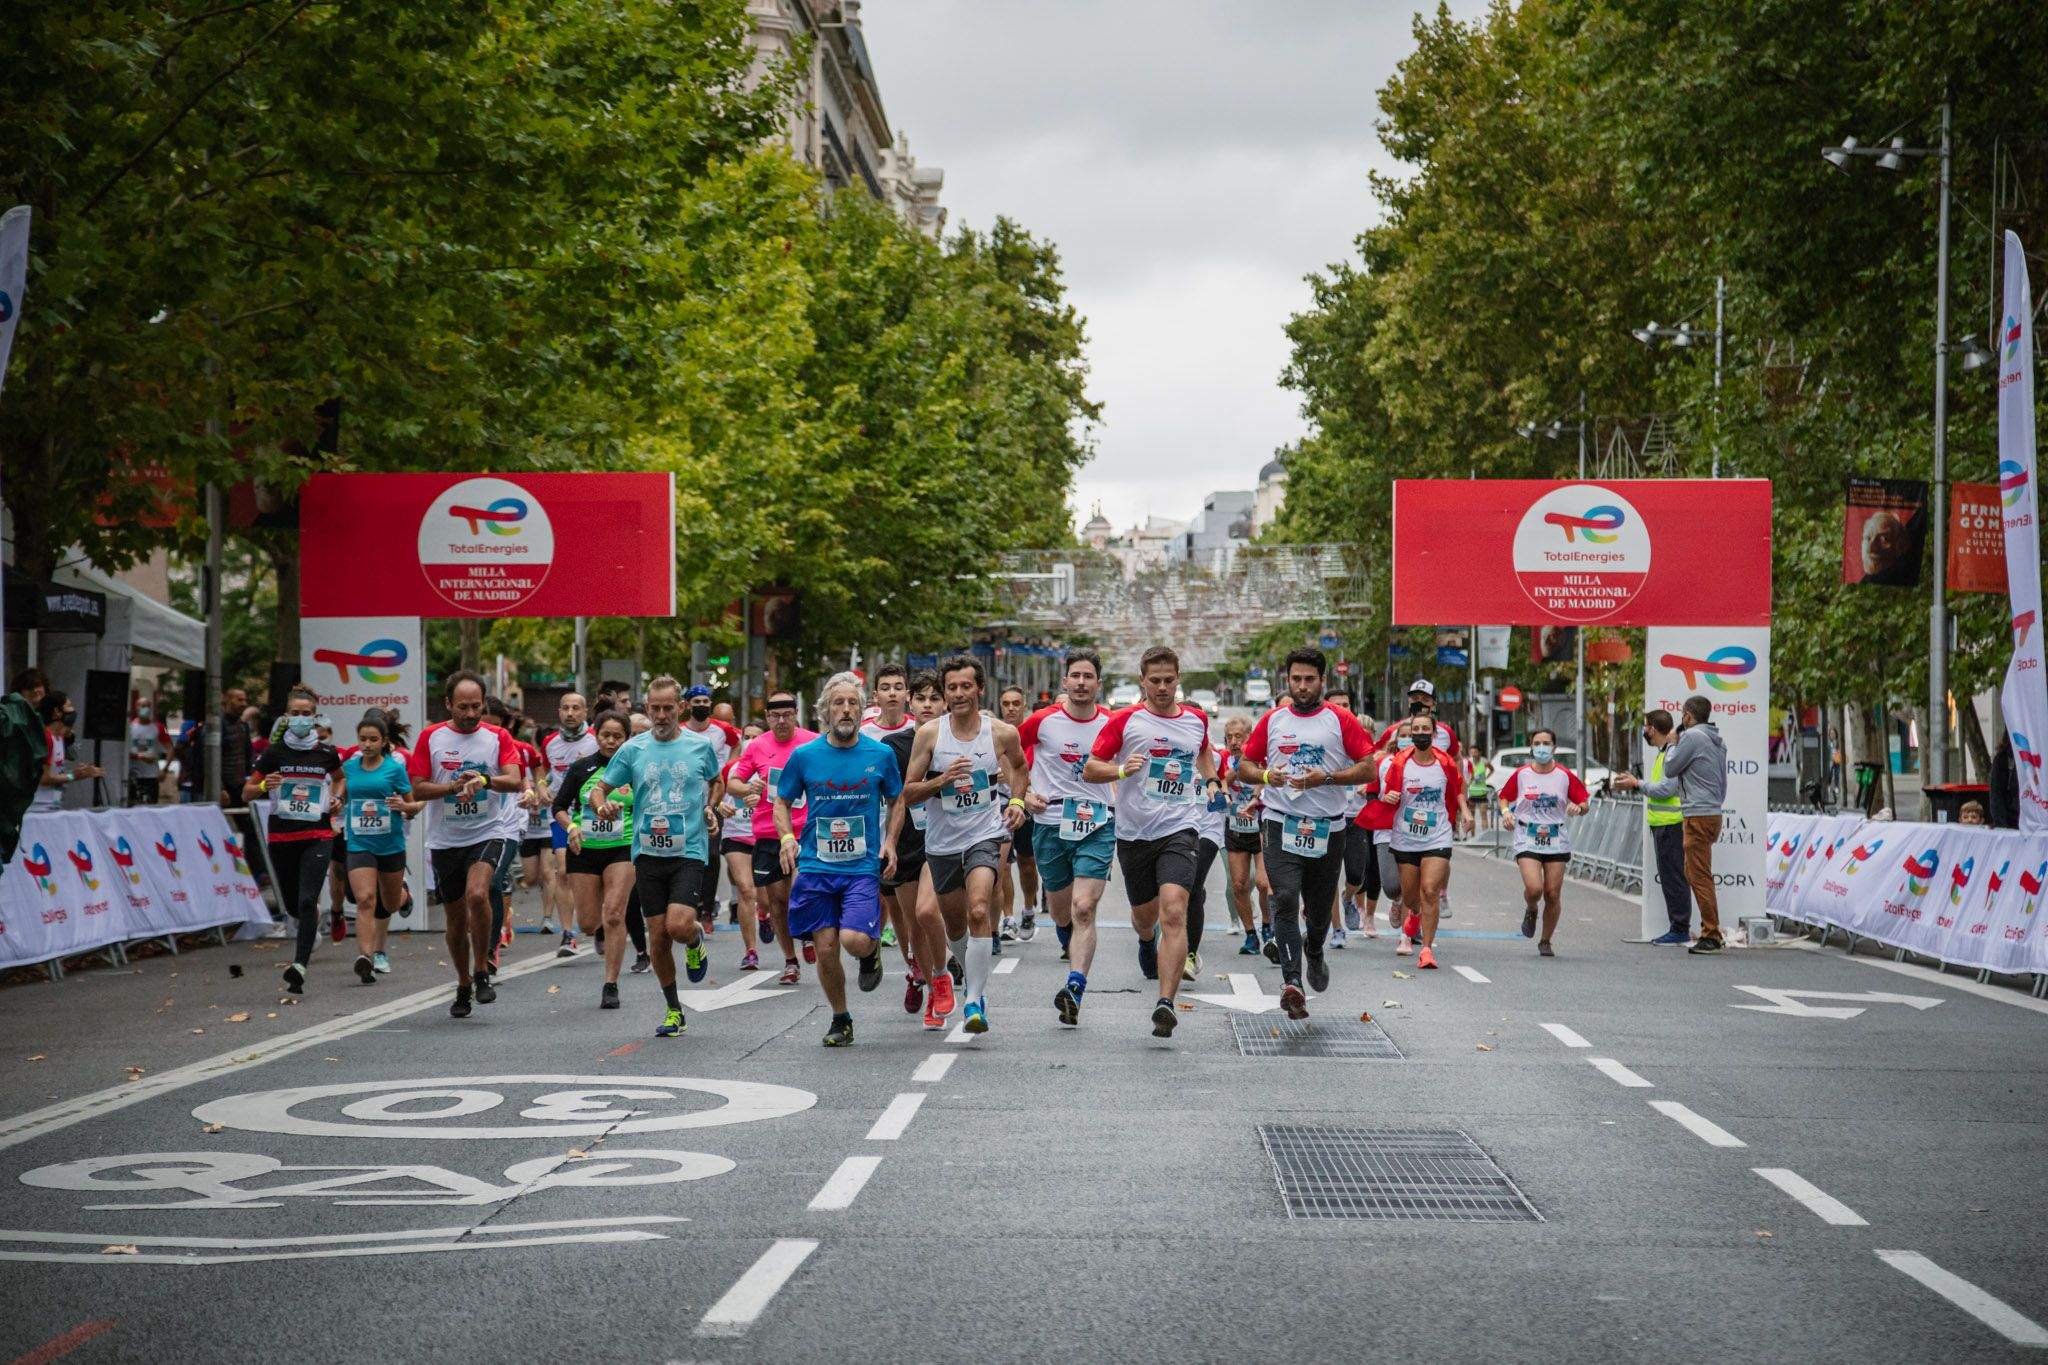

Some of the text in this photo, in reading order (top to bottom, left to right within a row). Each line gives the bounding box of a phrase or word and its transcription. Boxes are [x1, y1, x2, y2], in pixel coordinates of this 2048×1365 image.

[1961, 503, 2000, 516] FERN
[449, 543, 528, 555] TotalEnergies
[1544, 551, 1625, 564] TotalEnergies
[468, 567, 506, 577] MILLA
[1563, 575, 1601, 585] MILLA
[454, 591, 520, 600] DE MADRID
[1549, 599, 1616, 609] DE MADRID
[1156, 780, 1184, 796] 1029
[289, 801, 311, 813] 562
[955, 792, 980, 809] 262
[454, 802, 478, 815] 303
[358, 817, 383, 828] 1225
[591, 820, 613, 833] 580
[650, 835, 673, 849] 395
[826, 839, 855, 853] 1128
[1295, 835, 1315, 850] 579
